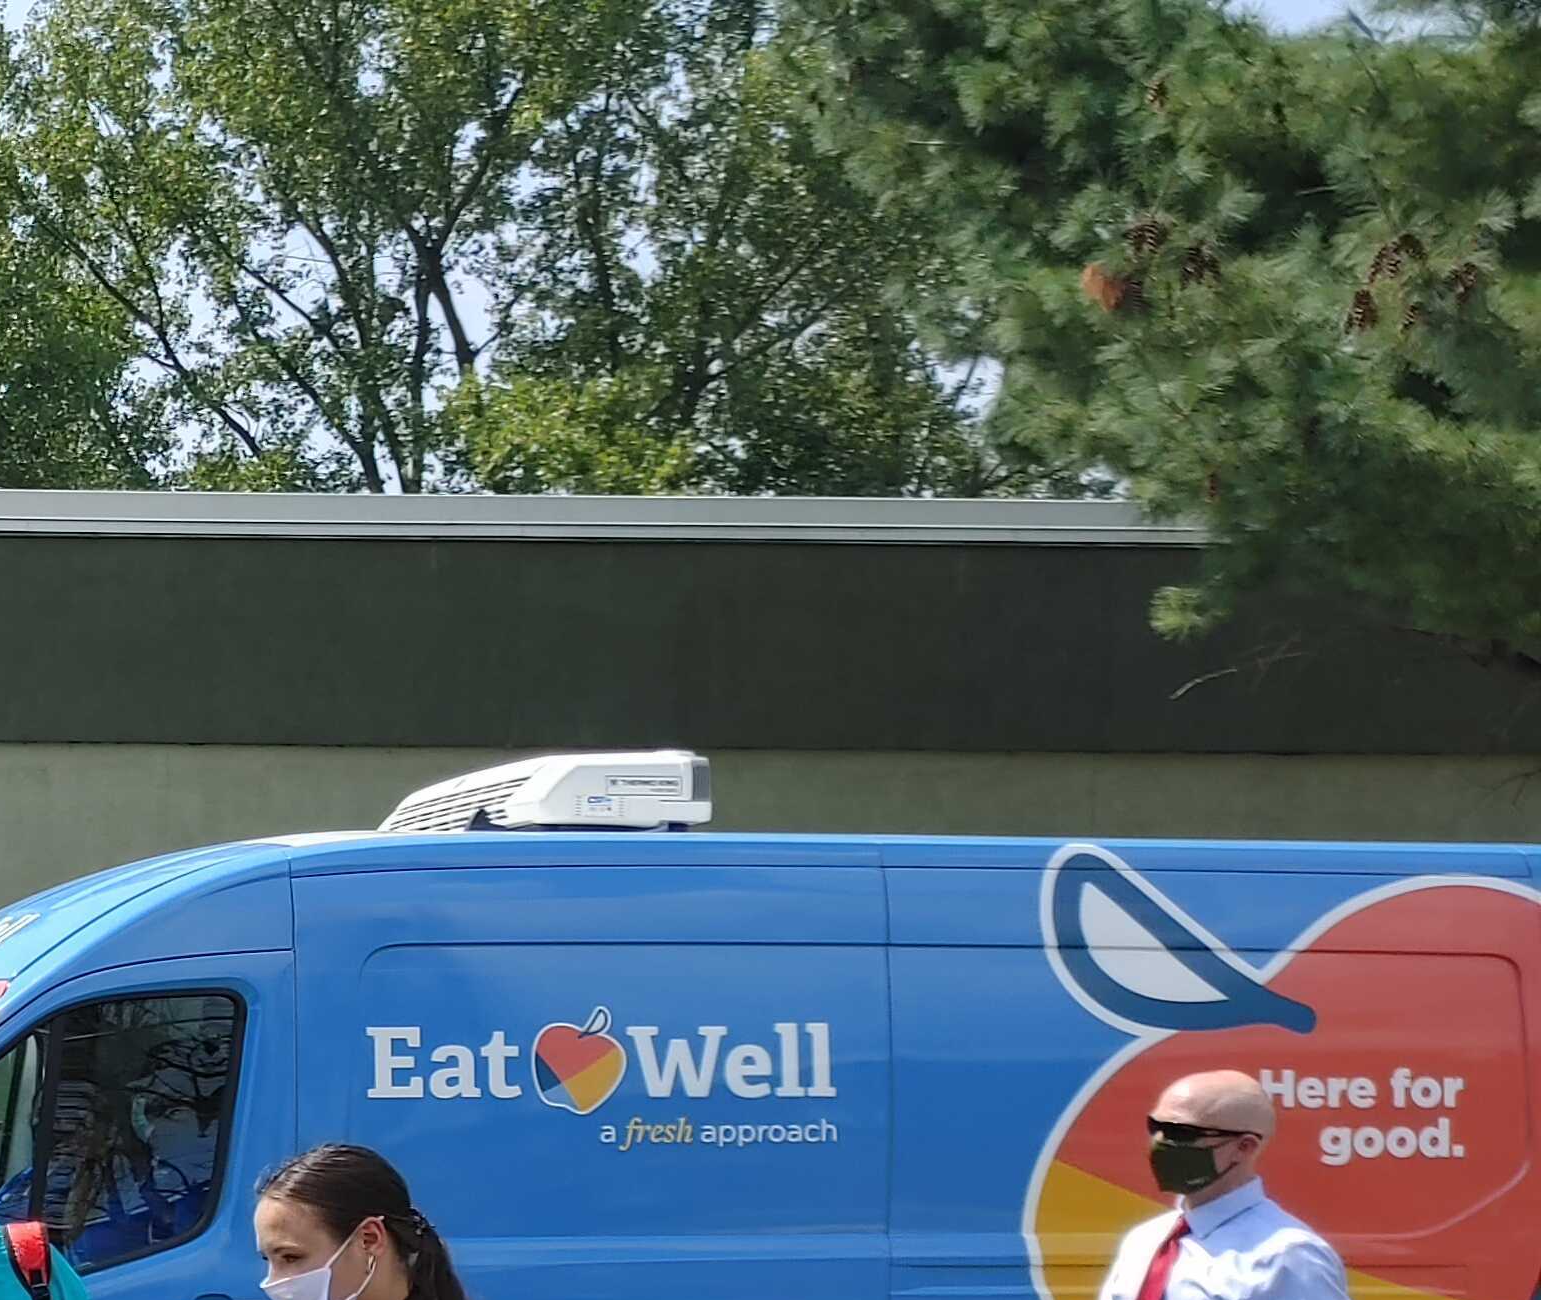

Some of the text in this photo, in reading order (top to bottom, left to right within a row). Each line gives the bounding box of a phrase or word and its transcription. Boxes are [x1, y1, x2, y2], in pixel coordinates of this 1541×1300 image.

[365, 1022, 837, 1099] Eat Well
[1259, 1067, 1465, 1110] Here for
[600, 1117, 838, 1152] a fresh approach
[1319, 1116, 1466, 1166] good.
